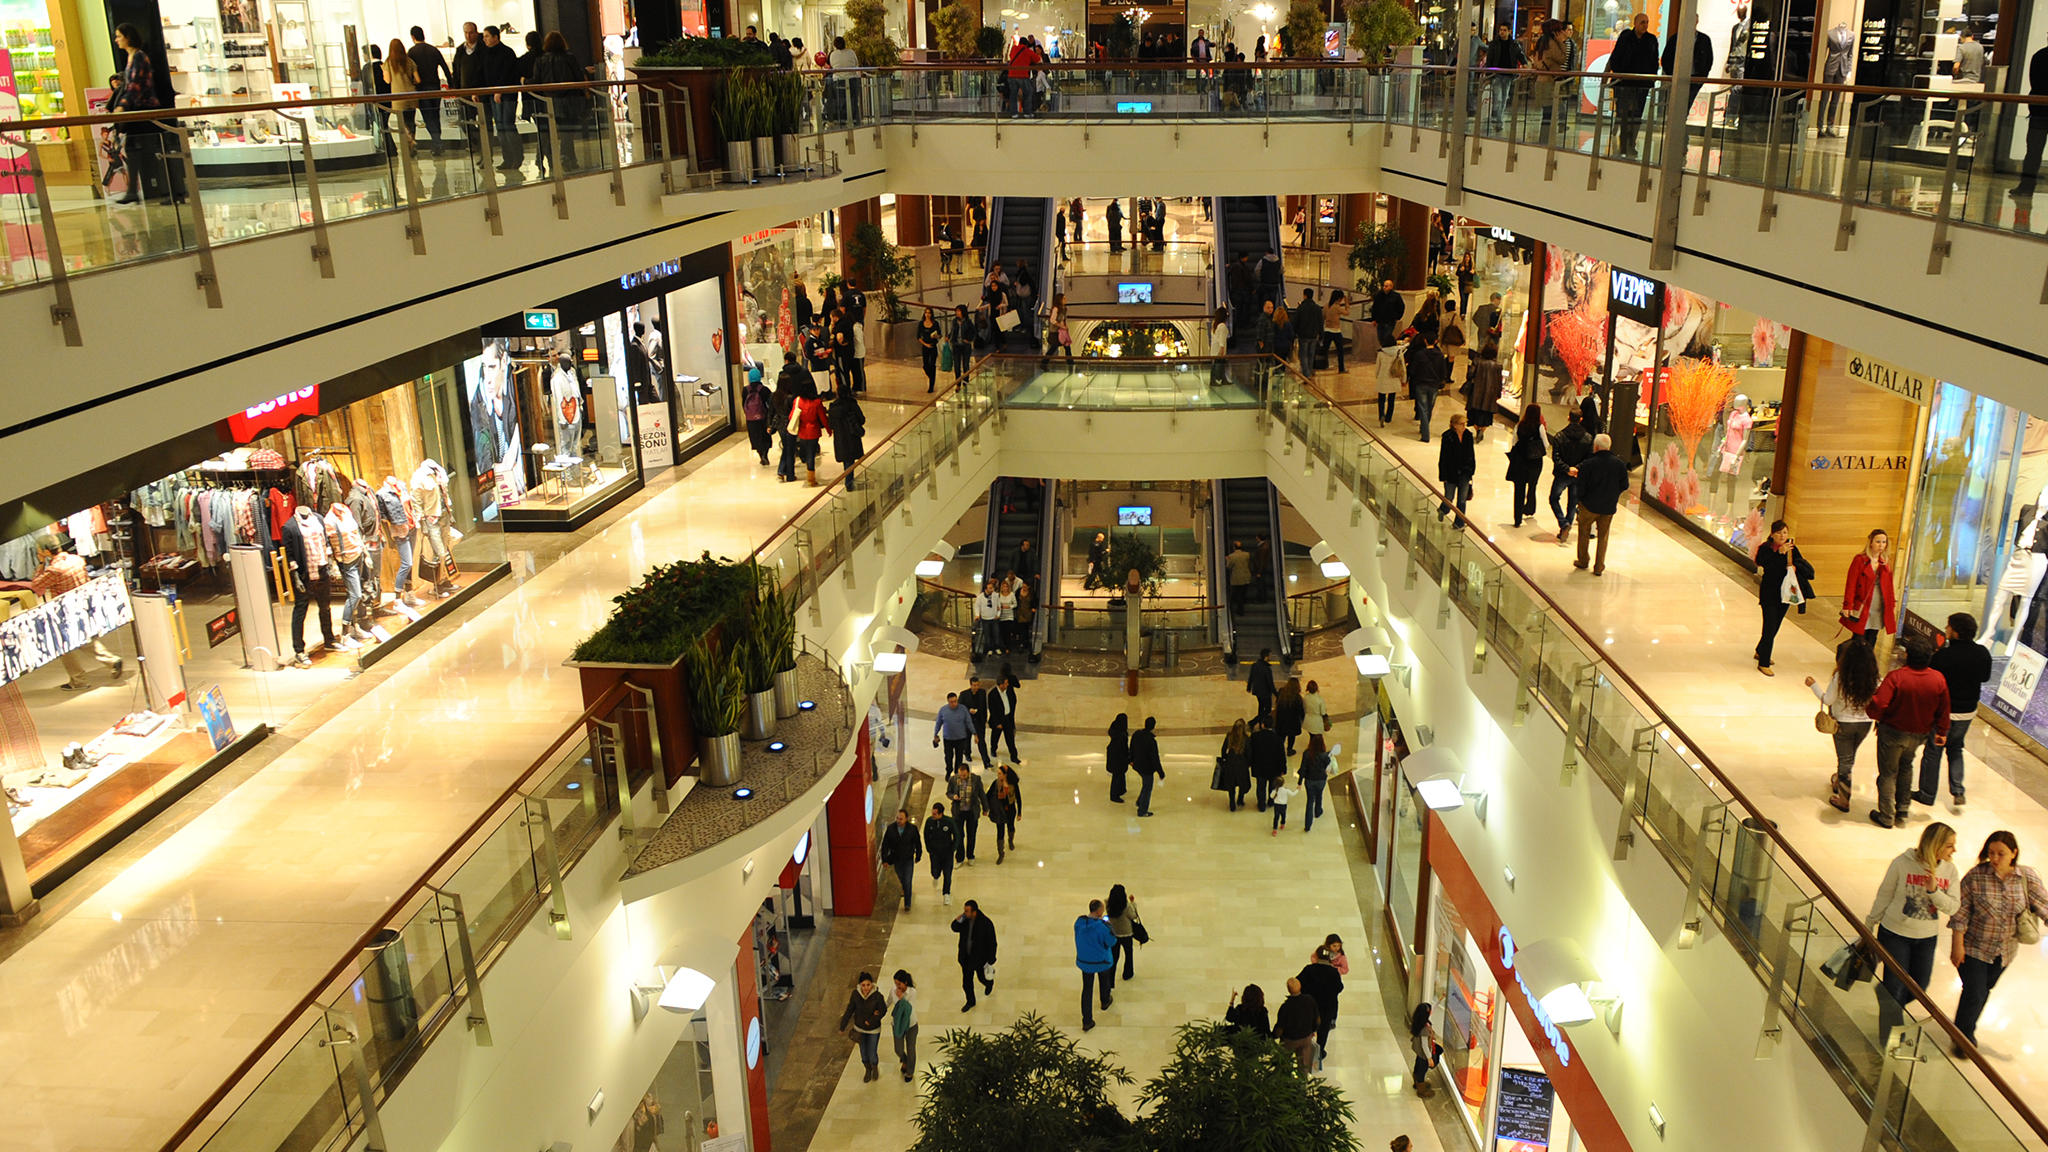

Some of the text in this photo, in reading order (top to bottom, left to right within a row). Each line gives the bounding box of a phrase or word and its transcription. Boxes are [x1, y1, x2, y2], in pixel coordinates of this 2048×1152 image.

[1863, 362, 1923, 401] ATALAR
[639, 431, 666, 441] SEZON
[640, 438, 668, 450] SONU
[1831, 456, 1908, 470] ATALAR
[1908, 616, 1933, 637] ATALAR
[2002, 677, 2028, 700] indirim
